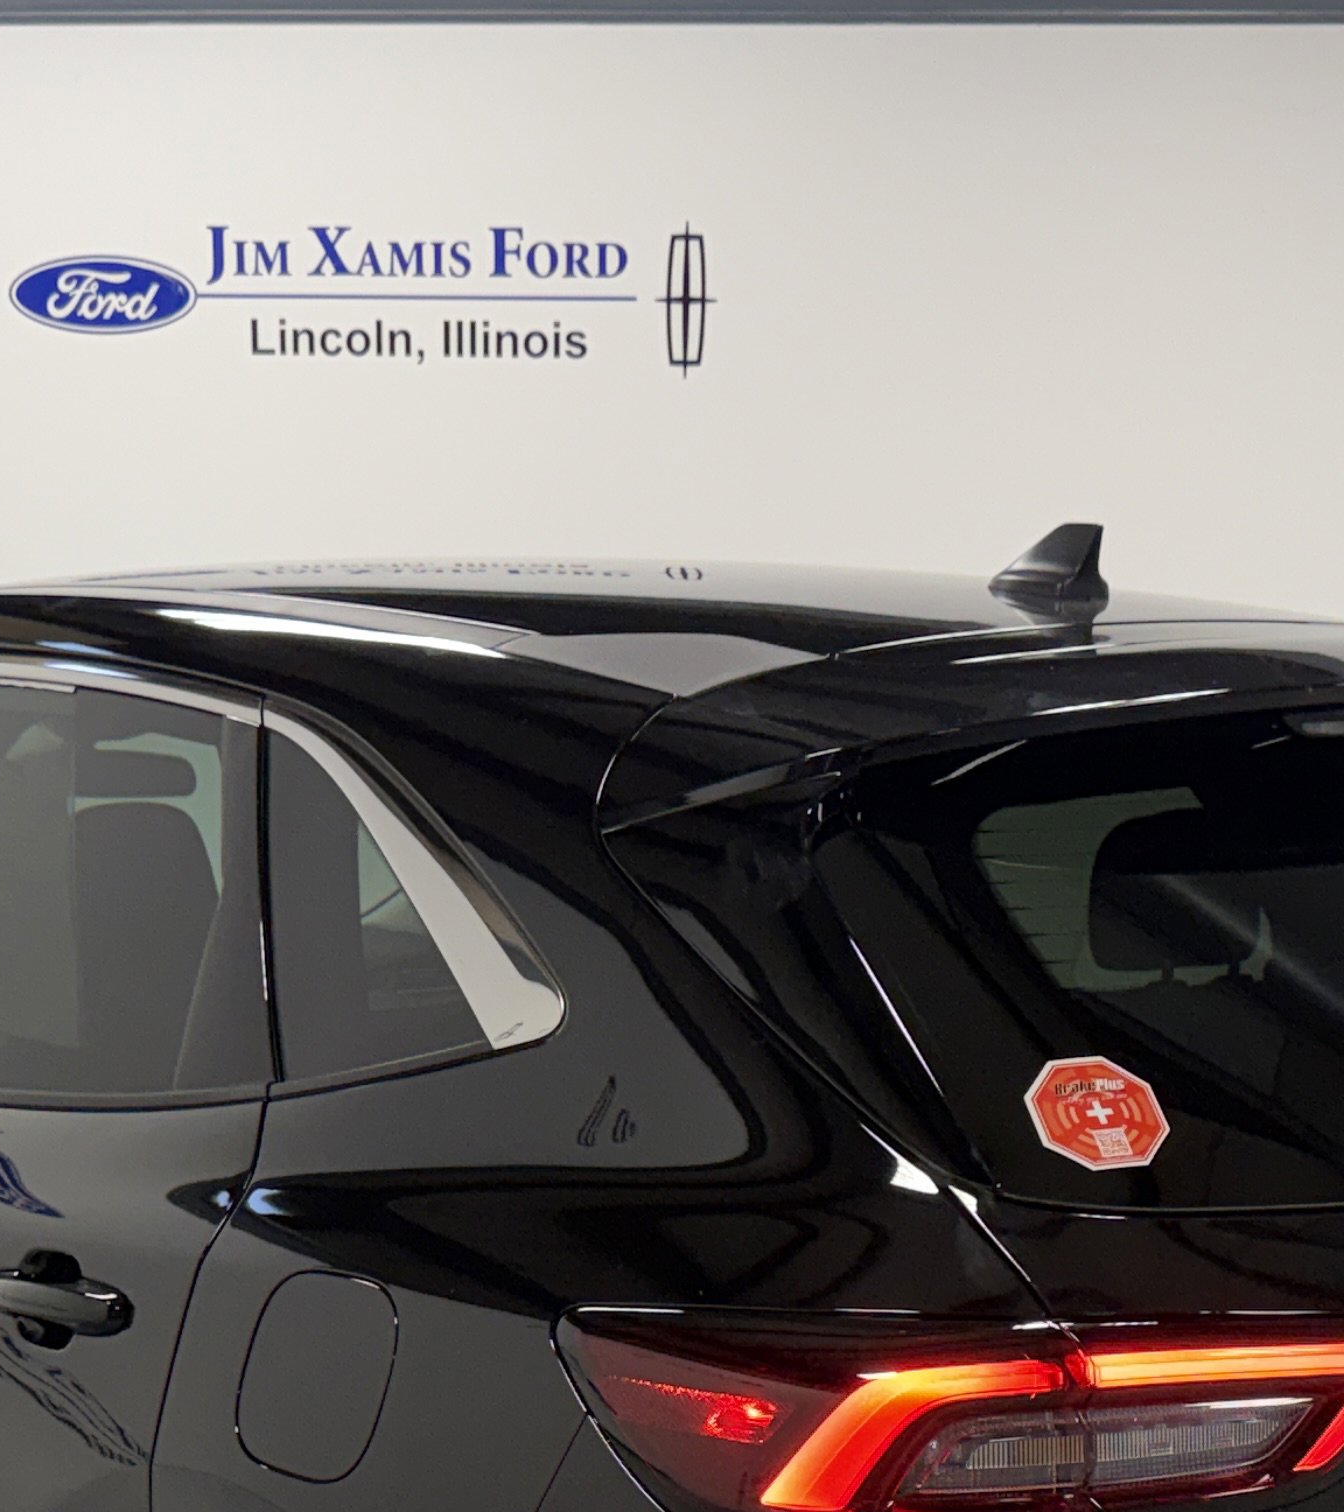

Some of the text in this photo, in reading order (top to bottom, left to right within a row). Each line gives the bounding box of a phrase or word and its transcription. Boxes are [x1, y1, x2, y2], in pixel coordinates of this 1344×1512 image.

[205, 226, 629, 286] JIM XAMIS FORD
[46, 273, 158, 325] Ford
[251, 319, 588, 365] Lincoln, Illinois
